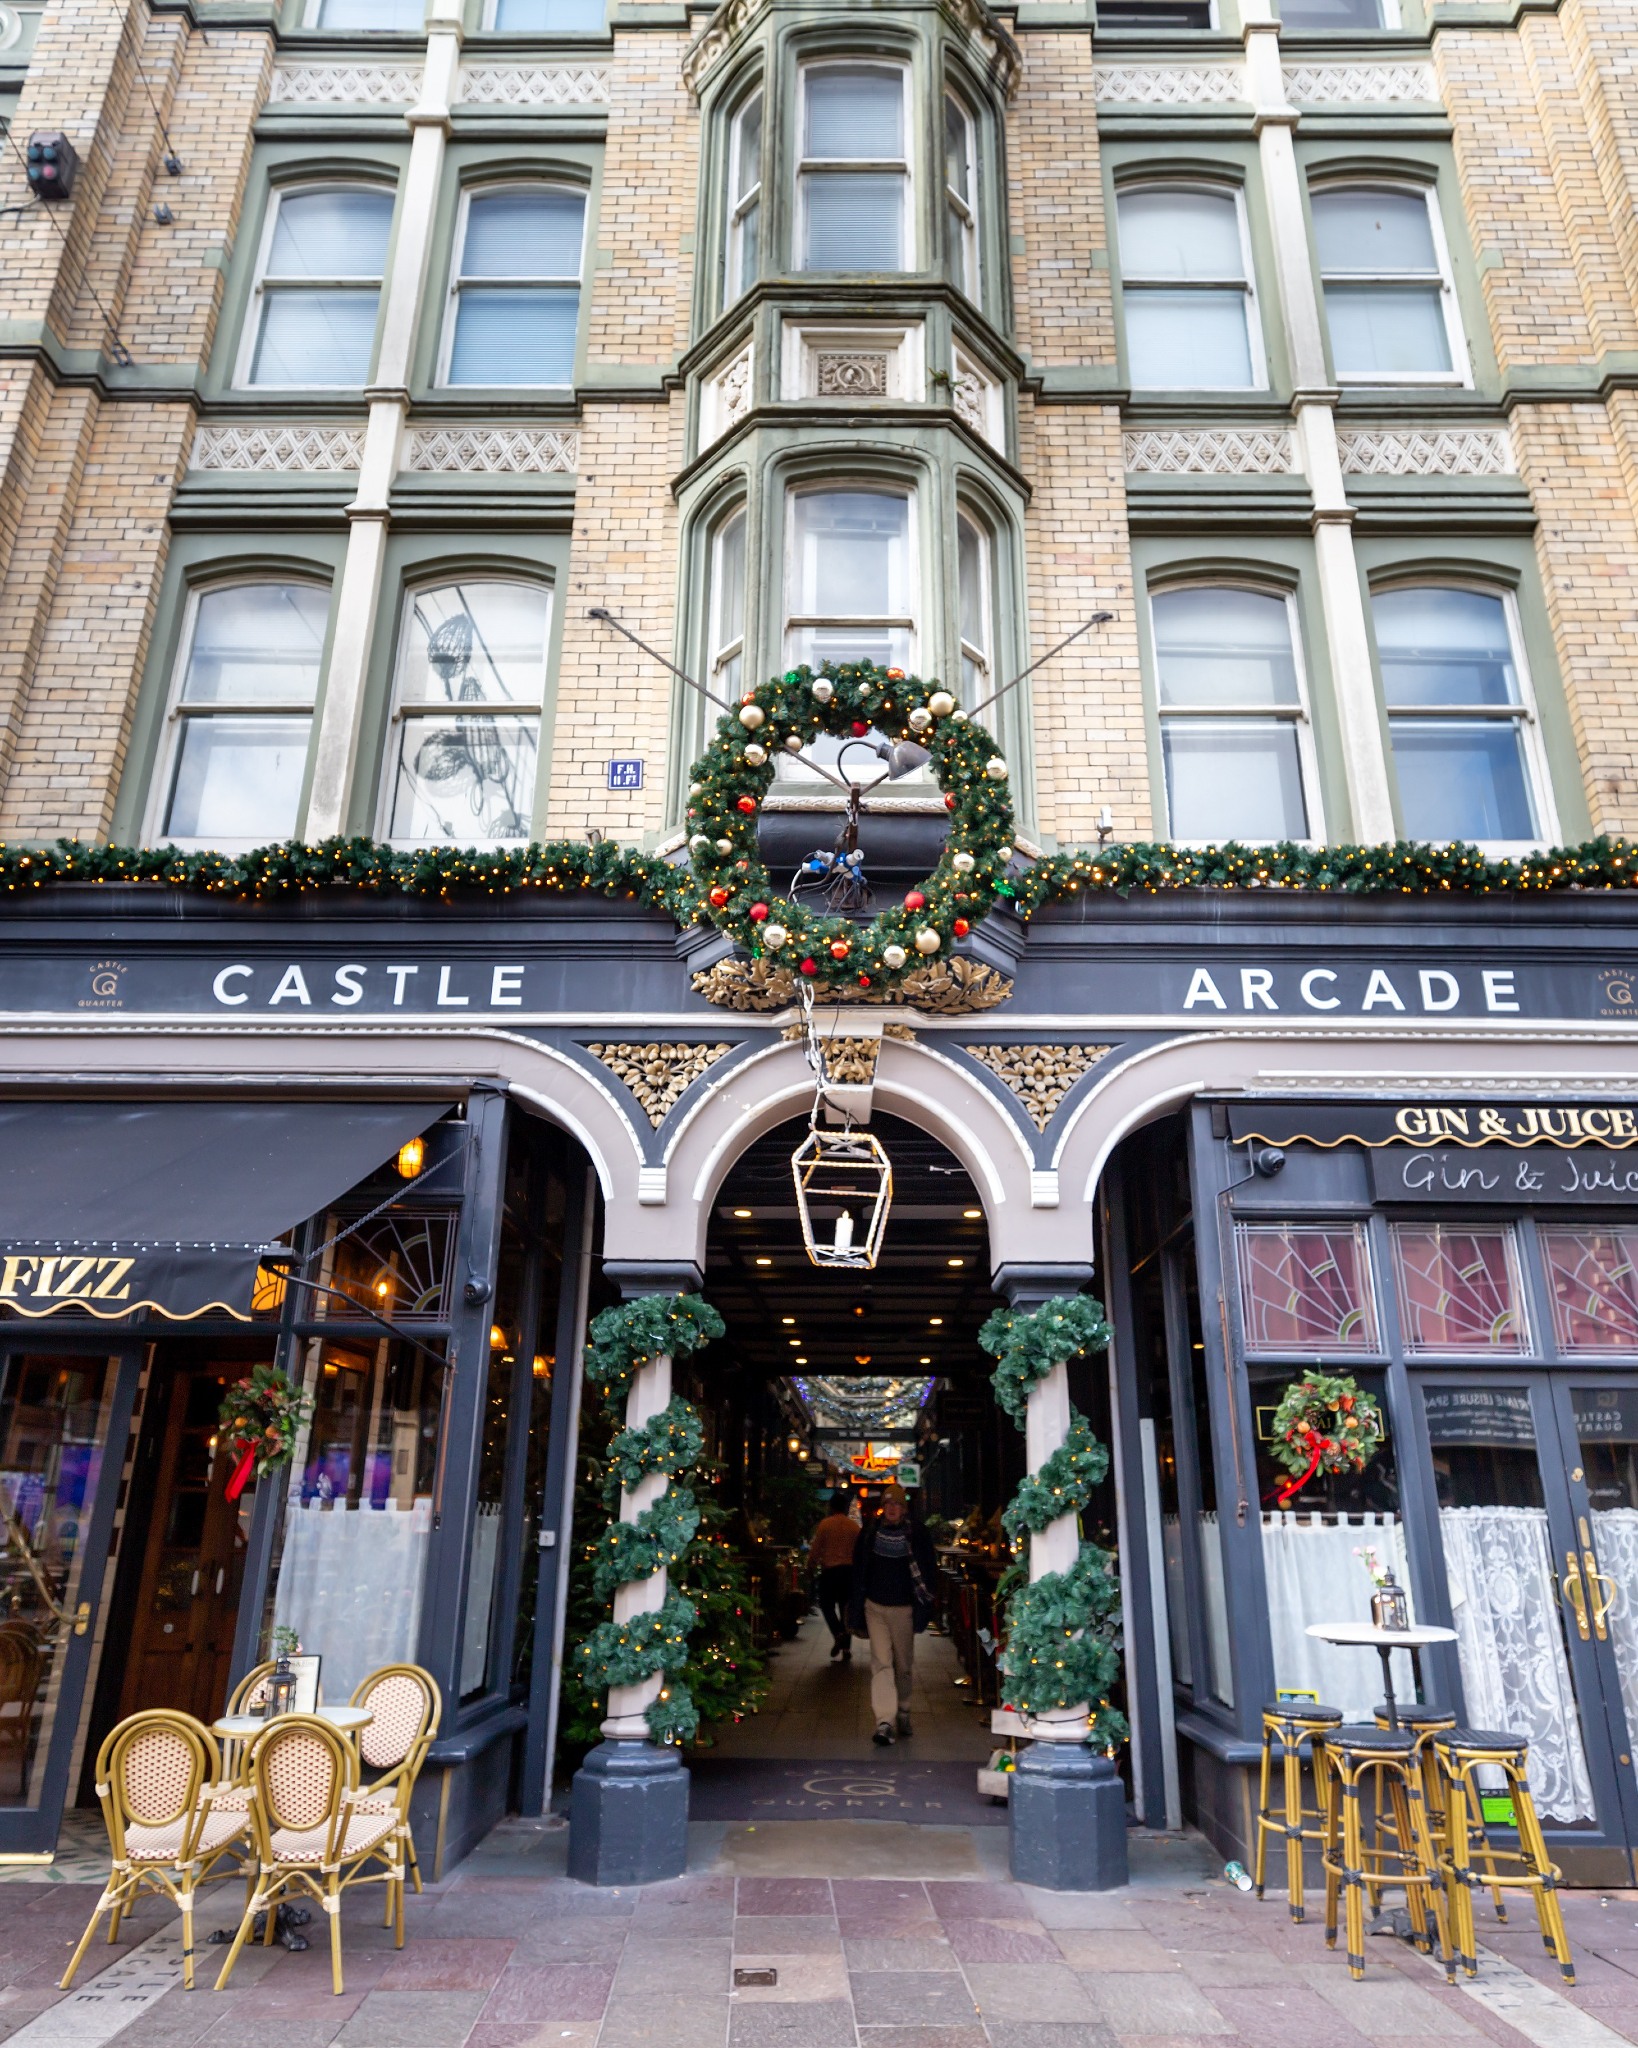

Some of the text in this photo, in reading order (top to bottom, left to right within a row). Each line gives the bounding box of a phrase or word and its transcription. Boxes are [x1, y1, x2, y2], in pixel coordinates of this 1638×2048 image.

[89, 960, 128, 974] CASTLE
[1598, 969, 1636, 982] CASTLE
[212, 964, 525, 1006] CASTLE
[1182, 967, 1521, 1013] ARCADE
[78, 1000, 123, 1008] QUARTER
[1395, 1107, 1638, 1138] GIN & JUICE
[1402, 1153, 1500, 1191] Gin
[1515, 1160, 1546, 1191] &
[0, 1255, 136, 1300] FIZZ
[751, 1798, 943, 1809] QUARTER
[75, 1937, 180, 2002] ARCADE
